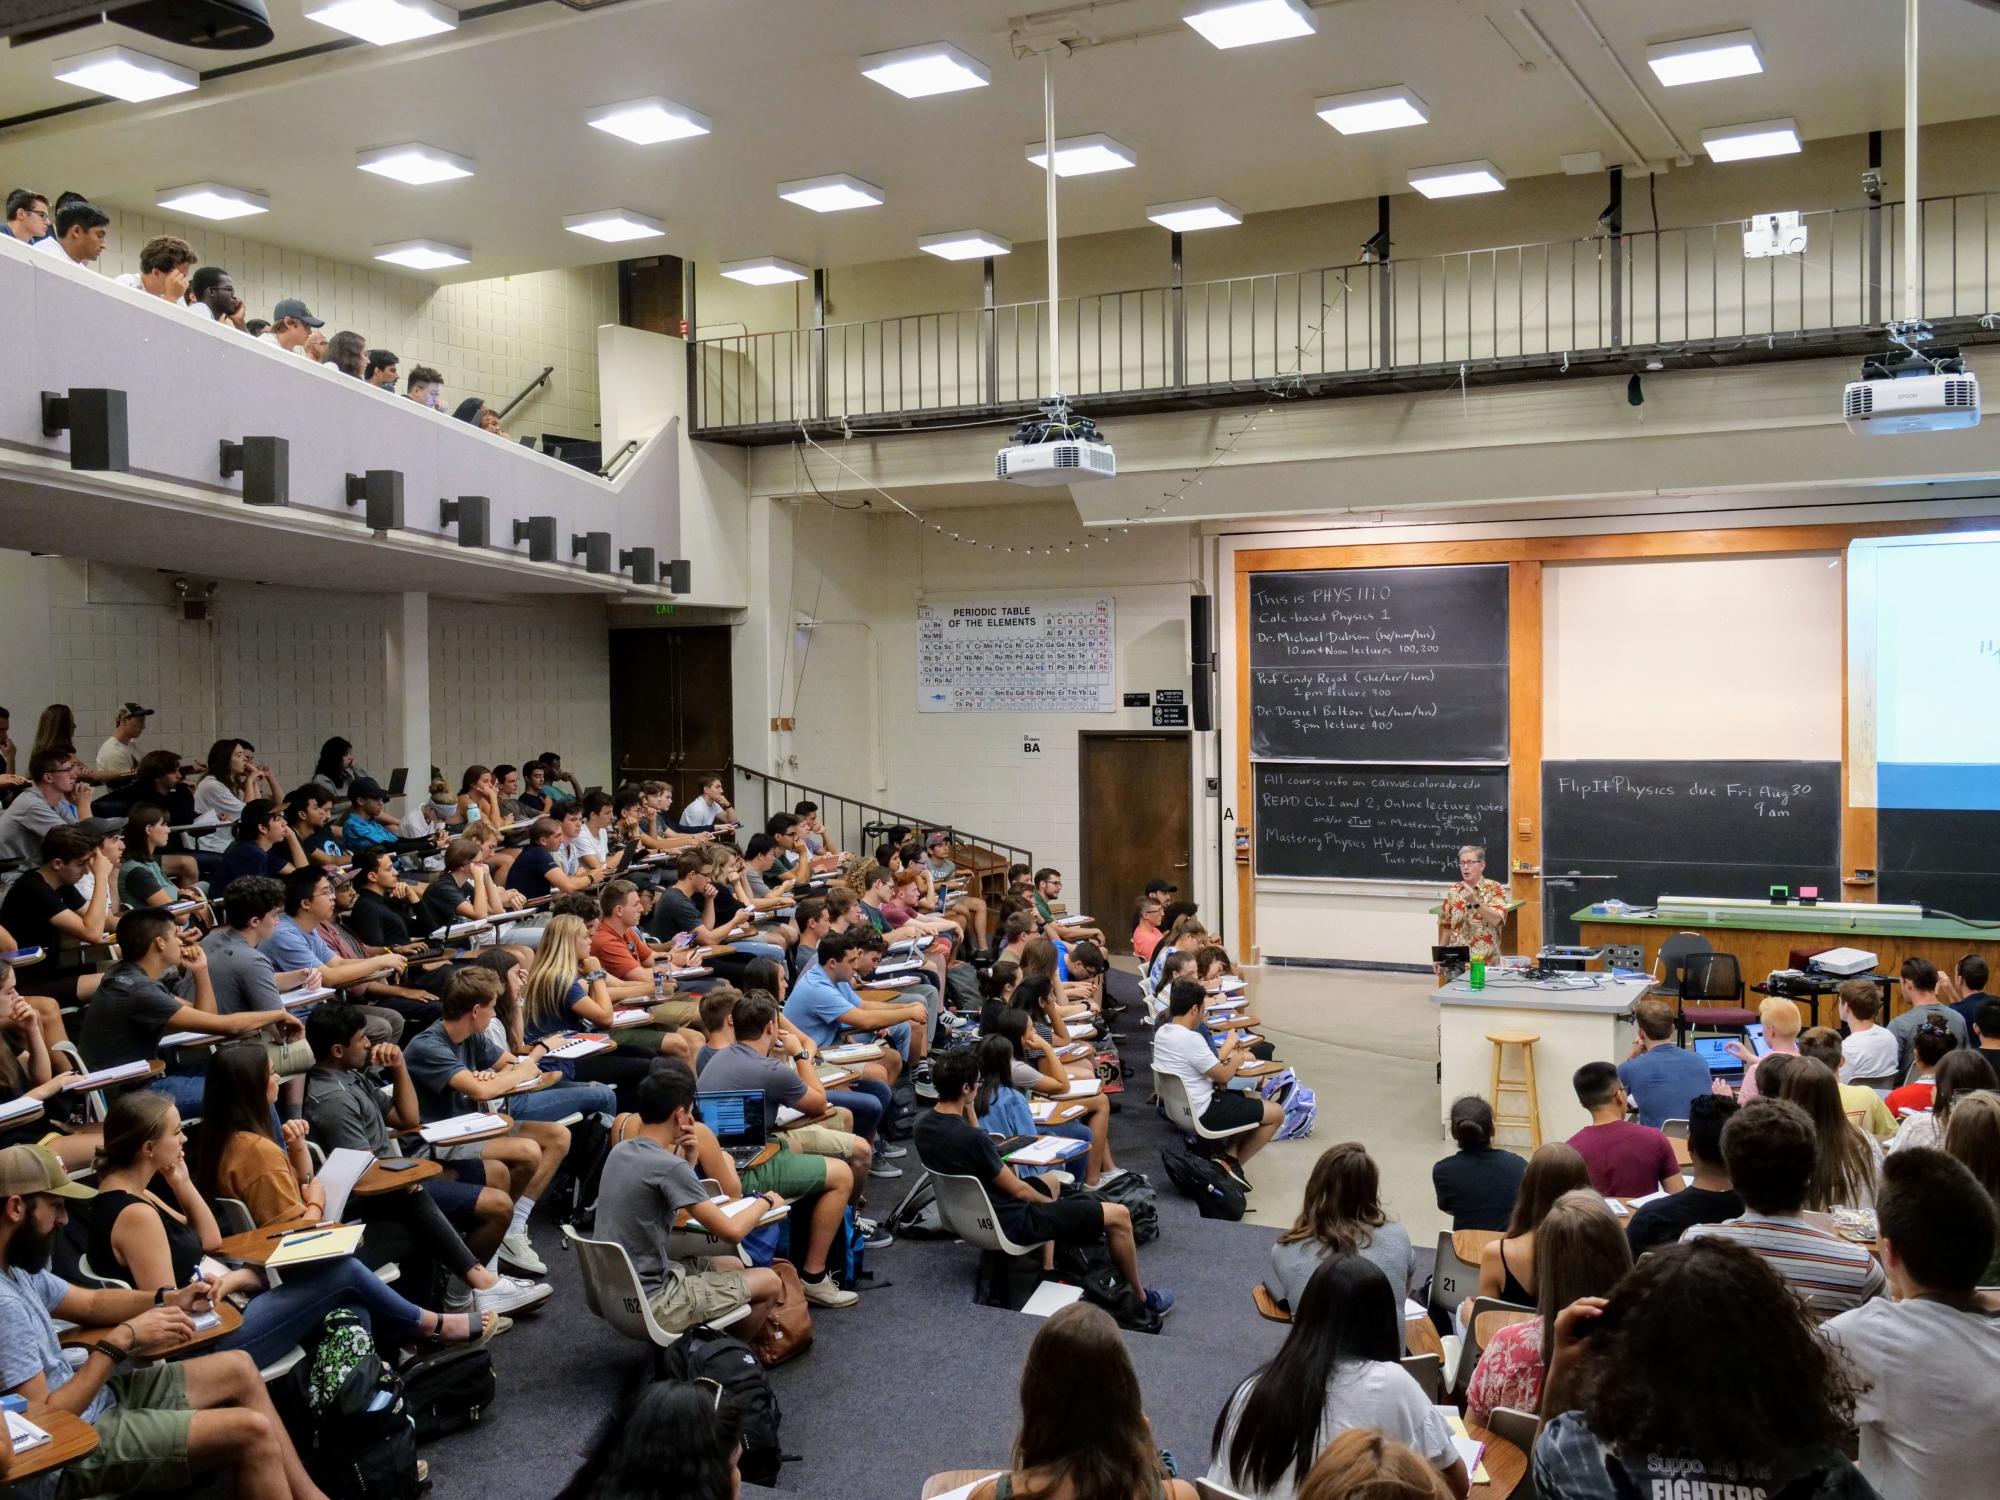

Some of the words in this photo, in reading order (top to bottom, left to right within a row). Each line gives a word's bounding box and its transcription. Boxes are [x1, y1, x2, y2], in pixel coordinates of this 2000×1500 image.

[1253, 590, 1287, 605] This
[1294, 595, 1304, 603] is
[1312, 587, 1352, 602] PHYS
[1359, 586, 1390, 600] 1110
[954, 608, 997, 616] PERIODIC
[1002, 606, 1030, 616] TABLE
[965, 619, 983, 627] THE
[988, 618, 1036, 627] ELEMENTS
[1260, 611, 1326, 623] Calc-based
[1331, 610, 1374, 626] Physics
[1380, 609, 1391, 619] 1
[1256, 633, 1275, 642] Dr.
[1278, 632, 1322, 642] Michael
[1326, 632, 1370, 642] Dubson
[1325, 645, 1347, 654] Noon
[1352, 644, 1391, 654] lectures
[1257, 672, 1278, 684] Prof
[1283, 673, 1312, 688] Cindy
[1327, 686, 1366, 697] lecture
[1255, 706, 1274, 716] Dr.
[1276, 706, 1316, 716] Daniel
[1322, 704, 1363, 716] Bolton
[1324, 720, 1365, 730] lecture
[1372, 720, 1392, 730] 400
[1024, 743, 1040, 752] BA
[1264, 774, 1282, 784] All
[1288, 778, 1320, 786] course
[1326, 776, 1347, 786] info
[1559, 775, 1675, 799] FlipItPhysics
[1689, 782, 1716, 796] due
[1727, 784, 1752, 796] Fri
[1760, 786, 1789, 805] Aug
[1791, 784, 1811, 795] 30
[1263, 792, 1300, 806] READ
[1328, 796, 1336, 806] 1
[1341, 798, 1358, 807] and
[1384, 799, 1422, 808] Online
[1426, 798, 1470, 810] lecture
[1477, 803, 1504, 811] notes
[1224, 808, 1234, 820] A
[1267, 828, 1321, 851] Mastering
[1324, 832, 1366, 852] Physics
[1410, 838, 1426, 849] due
[1411, 856, 1460, 872] midnight
[977, 1218, 994, 1230] 149
[1443, 1278, 1455, 1292] 21
[623, 1298, 642, 1314] 162
